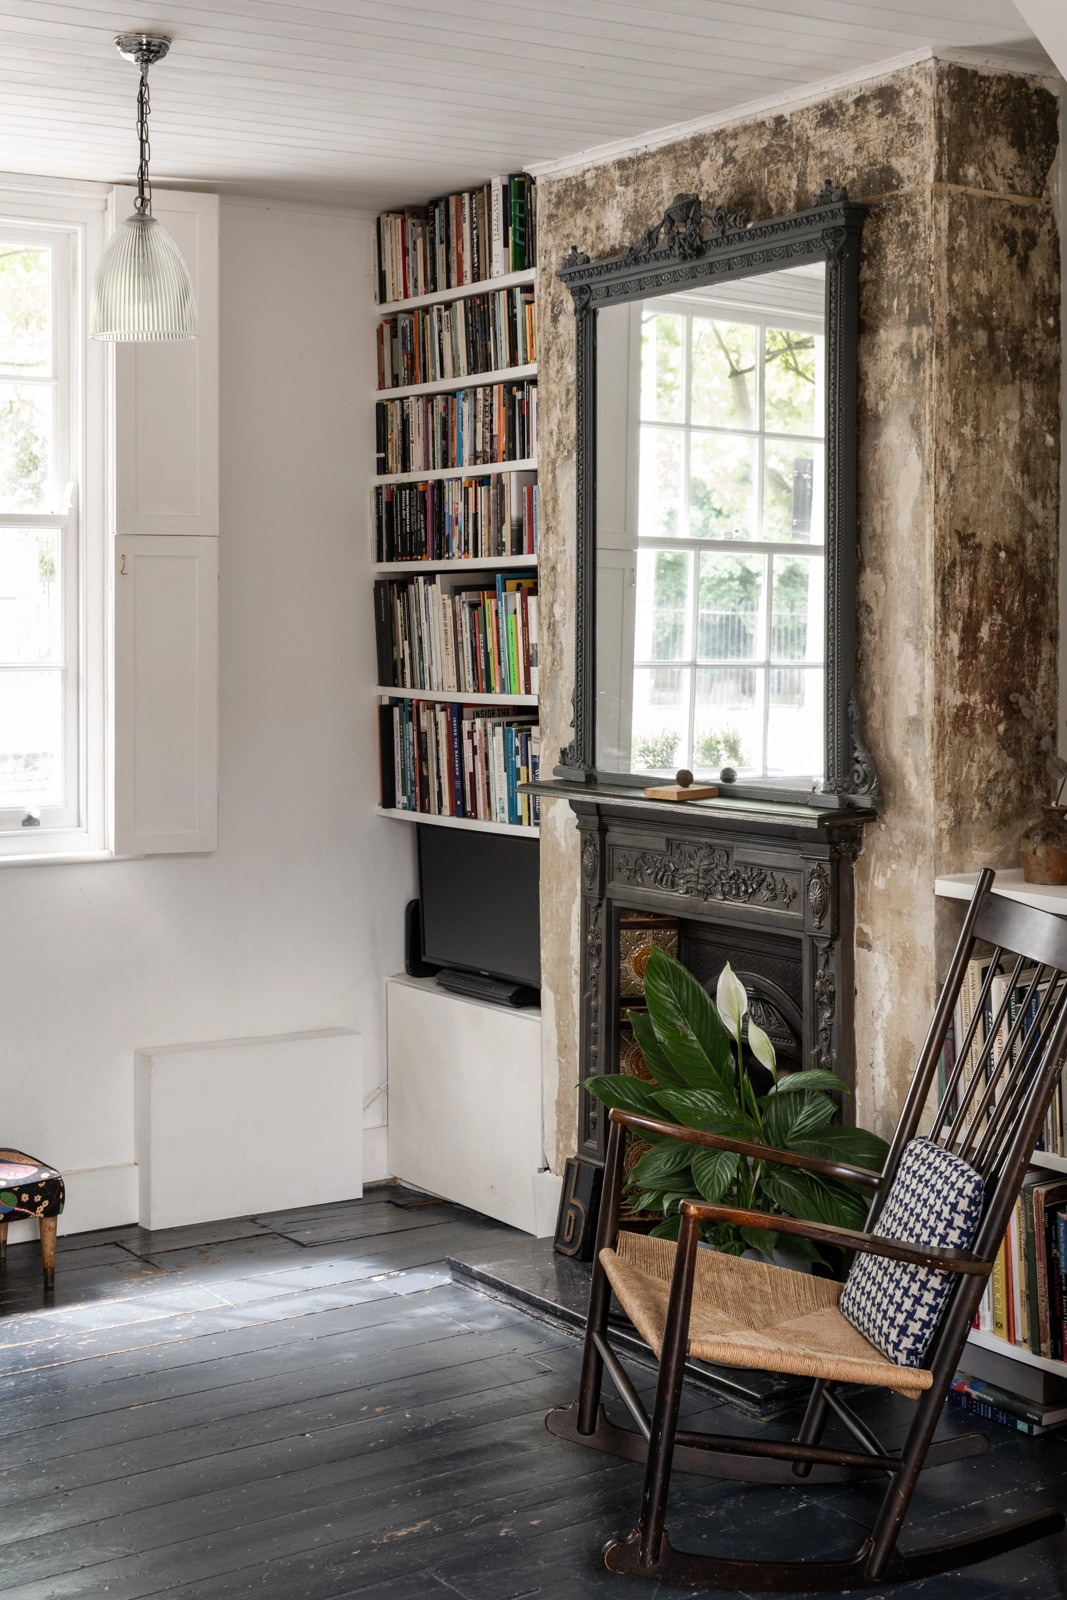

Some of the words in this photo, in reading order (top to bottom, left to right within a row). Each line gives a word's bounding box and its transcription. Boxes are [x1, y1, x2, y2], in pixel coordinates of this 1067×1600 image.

[473, 709, 496, 719] INSIDE
[498, 708, 511, 717] THE
[1026, 1192, 1034, 1233] Rembrandt
[993, 1275, 1003, 1315] GOGH
[1037, 1261, 1046, 1296] Albrecht
